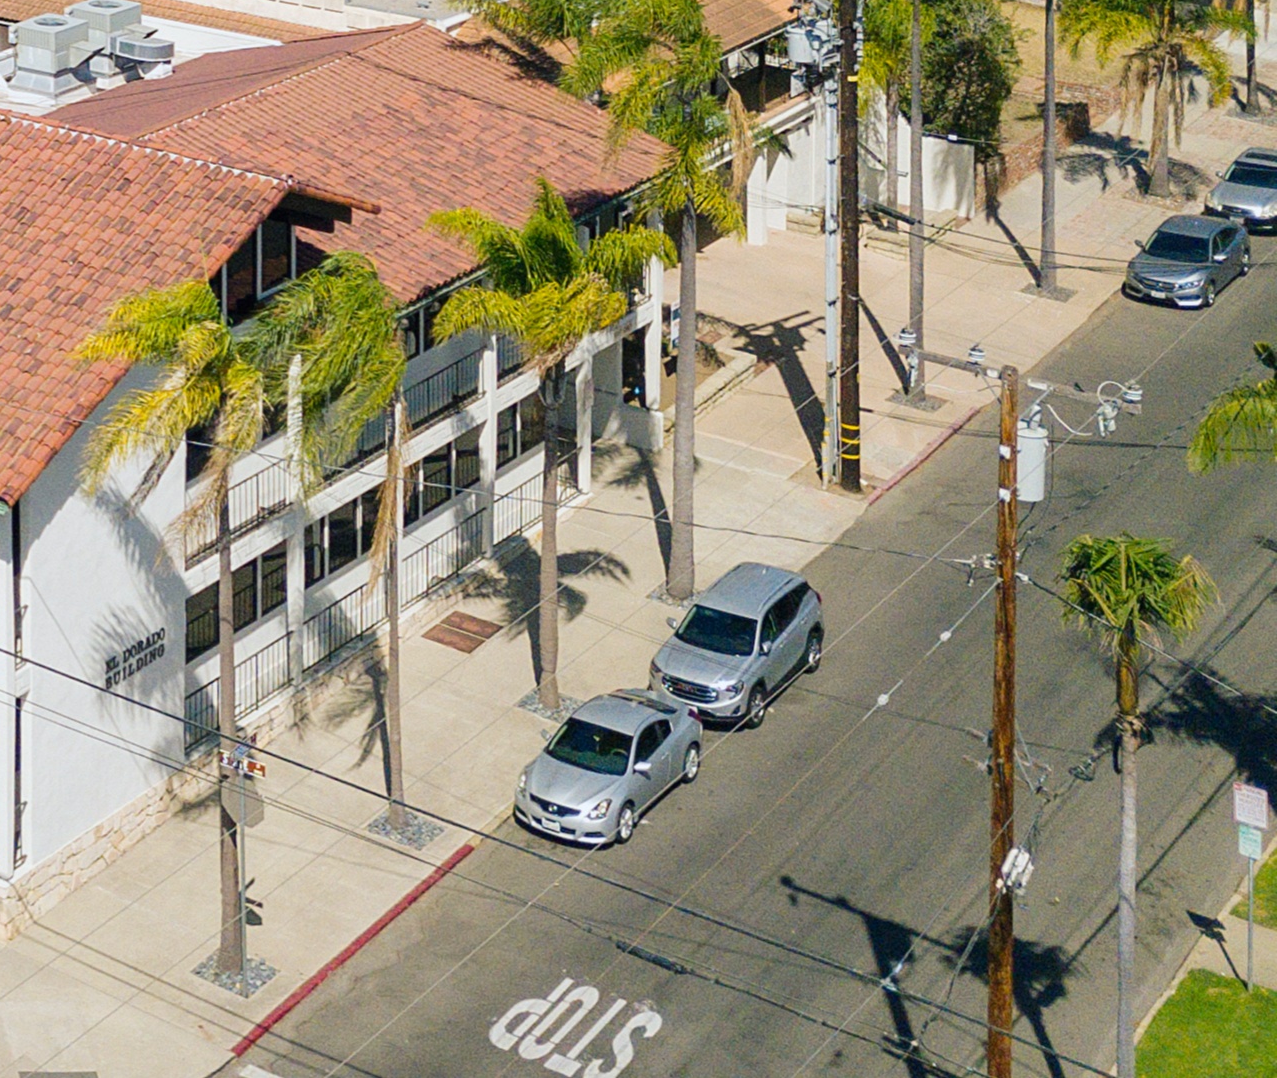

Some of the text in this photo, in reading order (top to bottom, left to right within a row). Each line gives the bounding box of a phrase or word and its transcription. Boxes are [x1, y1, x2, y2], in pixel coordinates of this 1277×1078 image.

[105, 627, 165, 675] EL DORADO
[105, 643, 165, 690] BUILDING
[489, 977, 663, 1078] STOP
